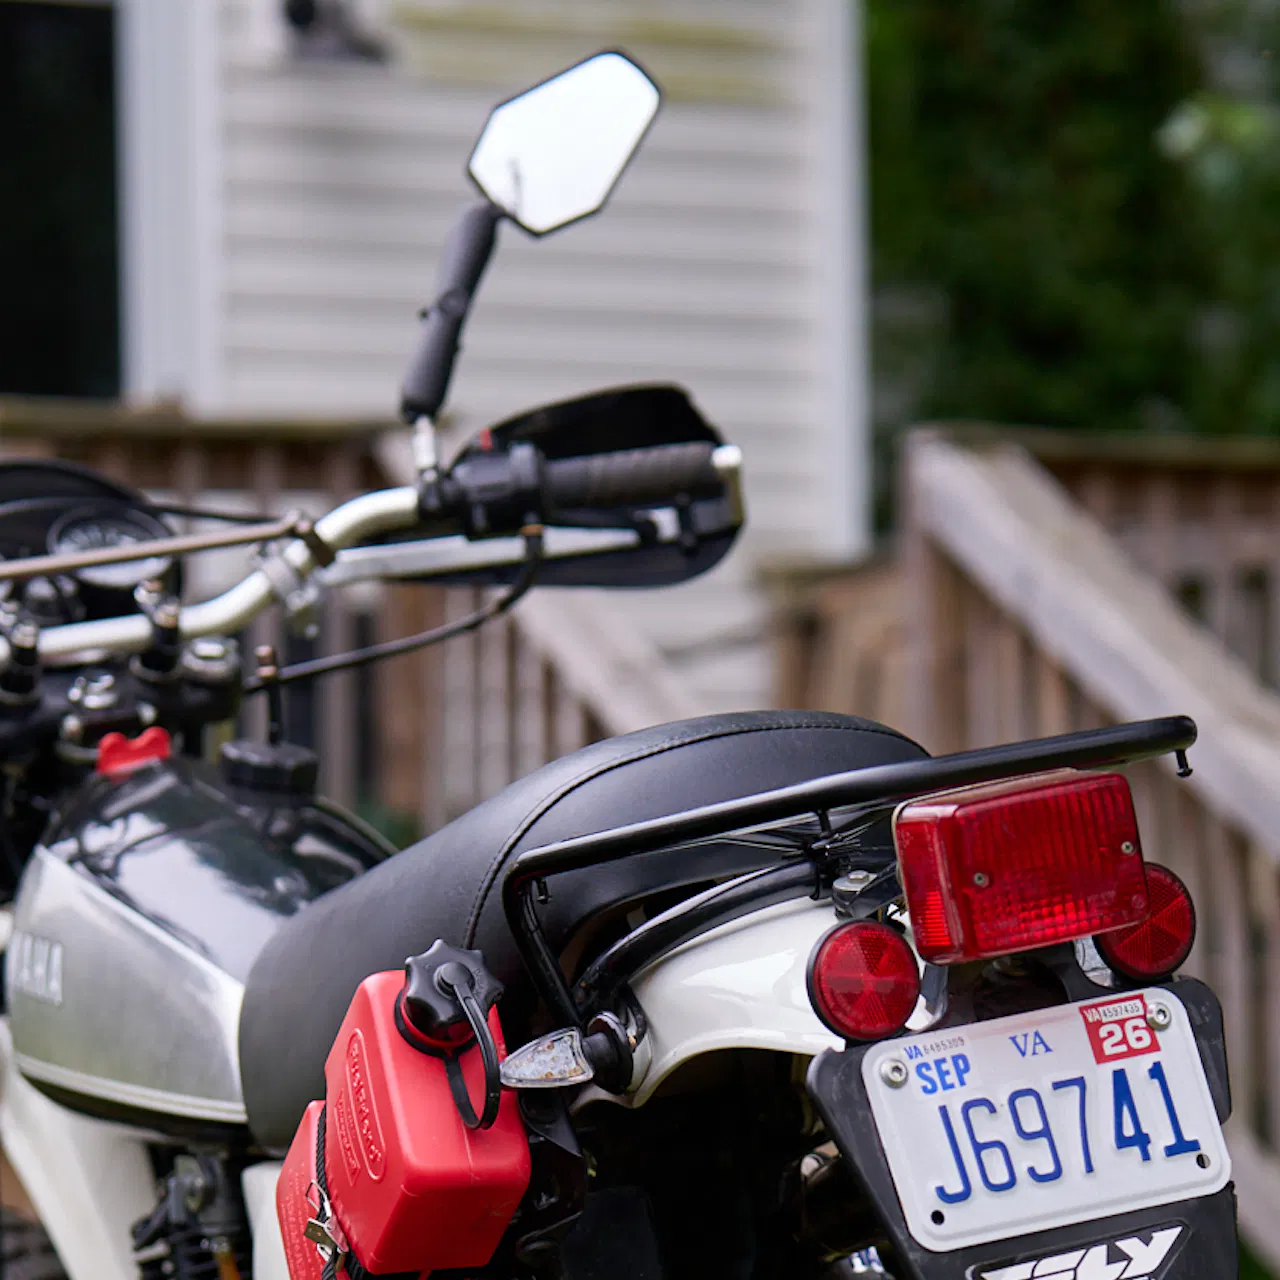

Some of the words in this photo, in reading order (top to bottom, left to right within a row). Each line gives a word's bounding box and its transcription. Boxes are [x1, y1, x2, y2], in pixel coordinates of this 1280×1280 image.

[1082, 1007, 1101, 1023] VA
[903, 1044, 923, 1060] VA
[1008, 1030, 1053, 1059] VA
[1098, 1018, 1152, 1056] 26
[915, 1053, 971, 1095] SEP
[934, 1060, 1201, 1204] J69741
